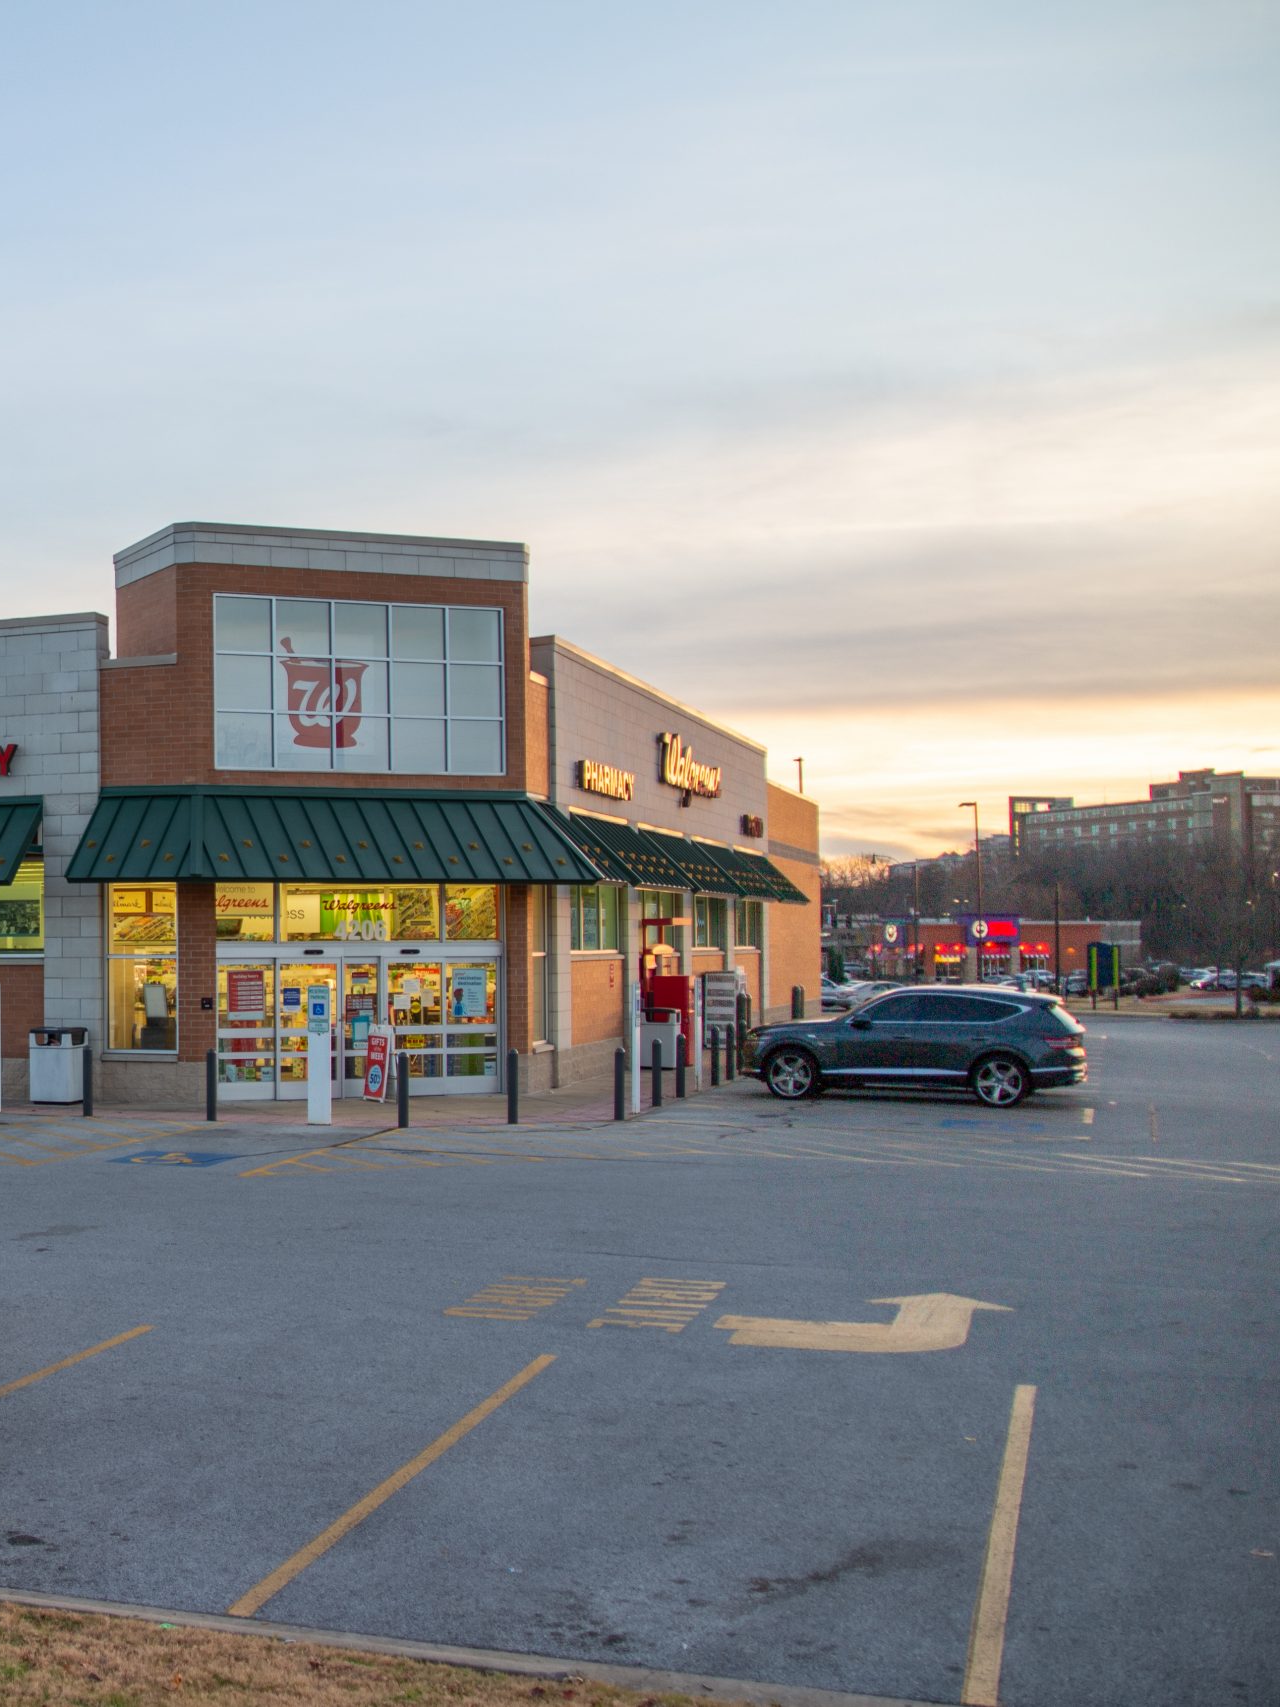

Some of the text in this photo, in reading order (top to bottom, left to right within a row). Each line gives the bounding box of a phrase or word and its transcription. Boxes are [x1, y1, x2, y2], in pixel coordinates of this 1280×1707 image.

[660, 731, 722, 807] Walgreens
[581, 759, 635, 801] PHARMACY
[215, 894, 269, 912] lgreens
[322, 899, 398, 914] Walgreens
[334, 919, 387, 941] 4206
[371, 1037, 385, 1046] GIFTS
[370, 1052, 385, 1061] WEEK
